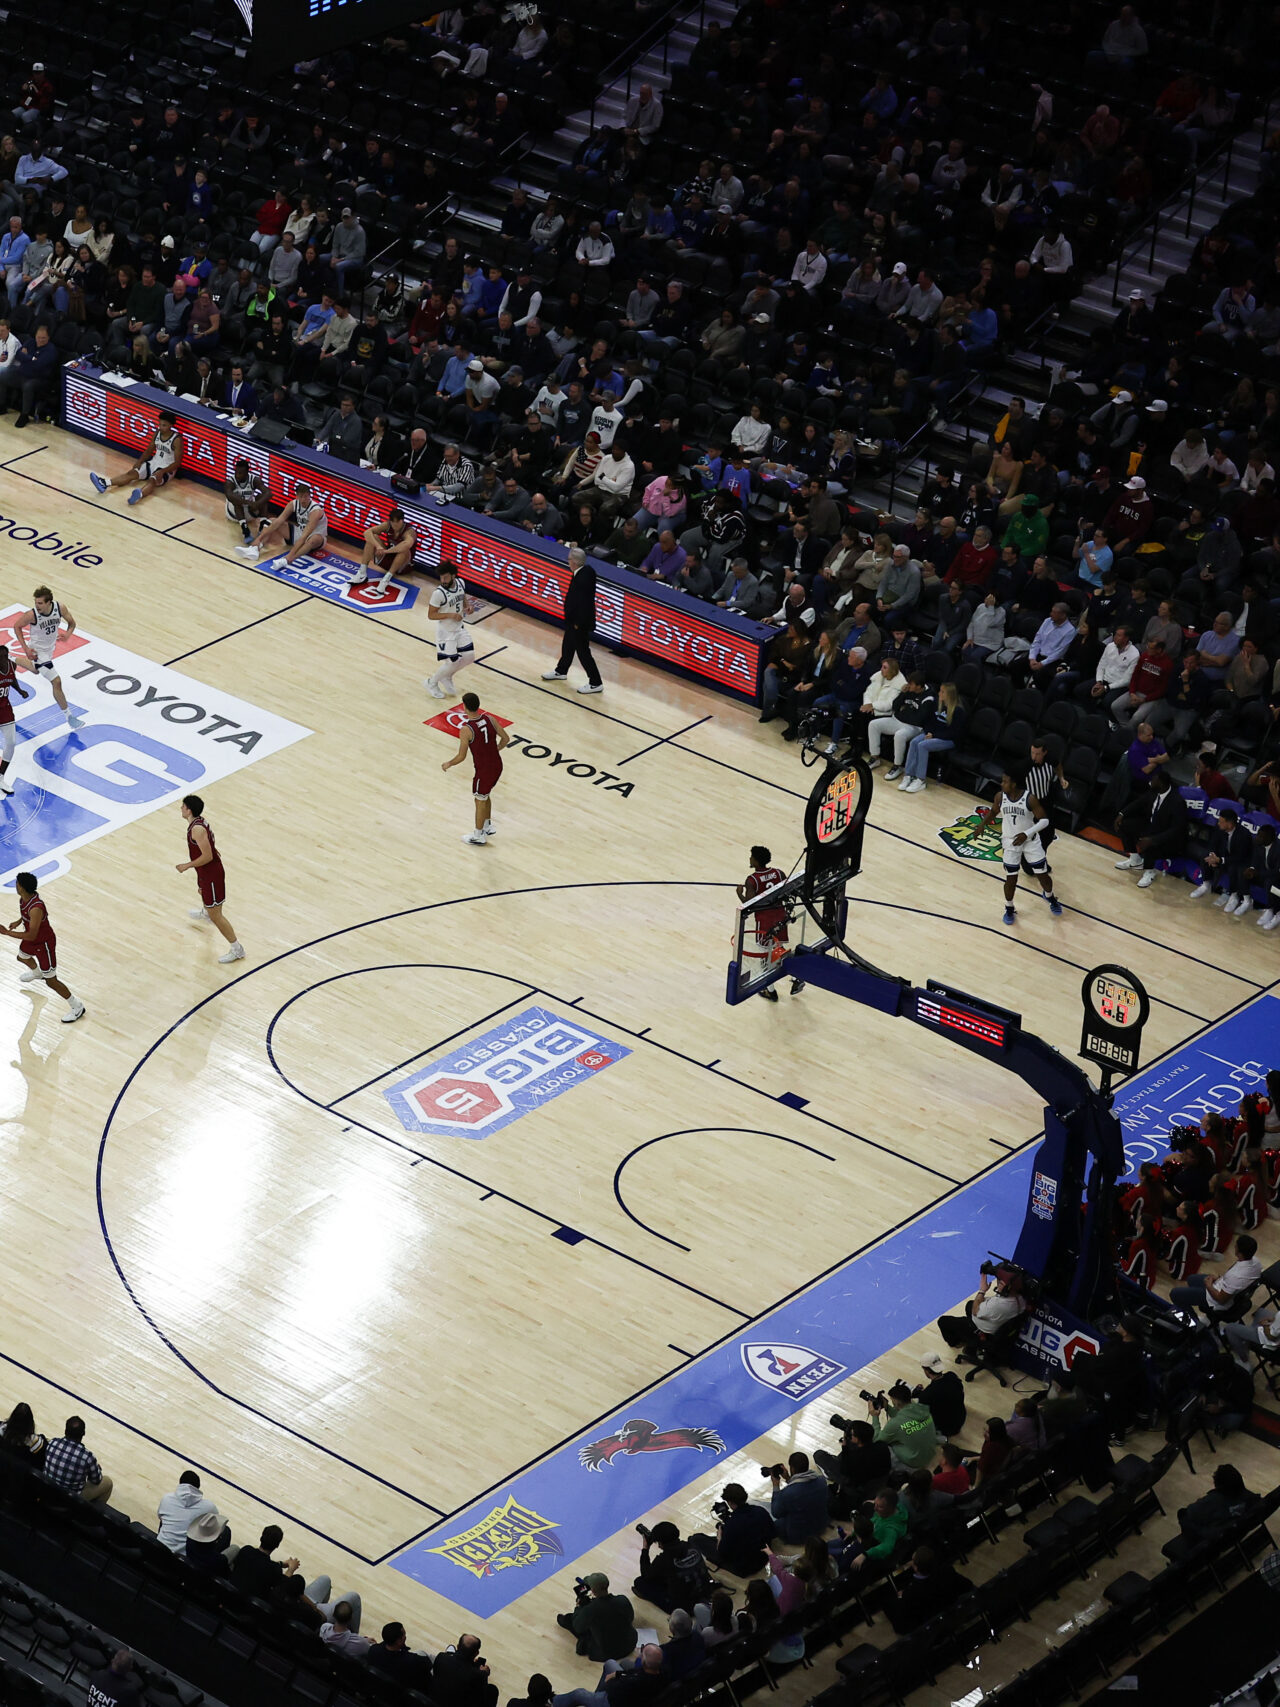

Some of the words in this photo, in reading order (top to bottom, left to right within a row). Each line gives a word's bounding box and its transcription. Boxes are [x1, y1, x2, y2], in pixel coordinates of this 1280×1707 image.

[280, 569, 337, 594] LASSIC
[451, 538, 565, 605] TOYOTA
[45, 625, 57, 635] 33
[634, 609, 752, 680] TOYOTA
[71, 659, 264, 755] TOYOTA
[480, 726, 489, 743] 7
[506, 734, 636, 798] TOYOTA
[1011, 815, 1017, 825] 7
[454, 1018, 546, 1071] CLASSIC
[485, 1029, 585, 1085] BIG
[531, 1068, 585, 1096] TOYOTA
[435, 1088, 485, 1115] 5
[1121, 1104, 1165, 1132] LAW
[1035, 1179, 1055, 1194] BIG
[1017, 1343, 1059, 1366] ASSIC
[786, 1361, 836, 1395] PENN
